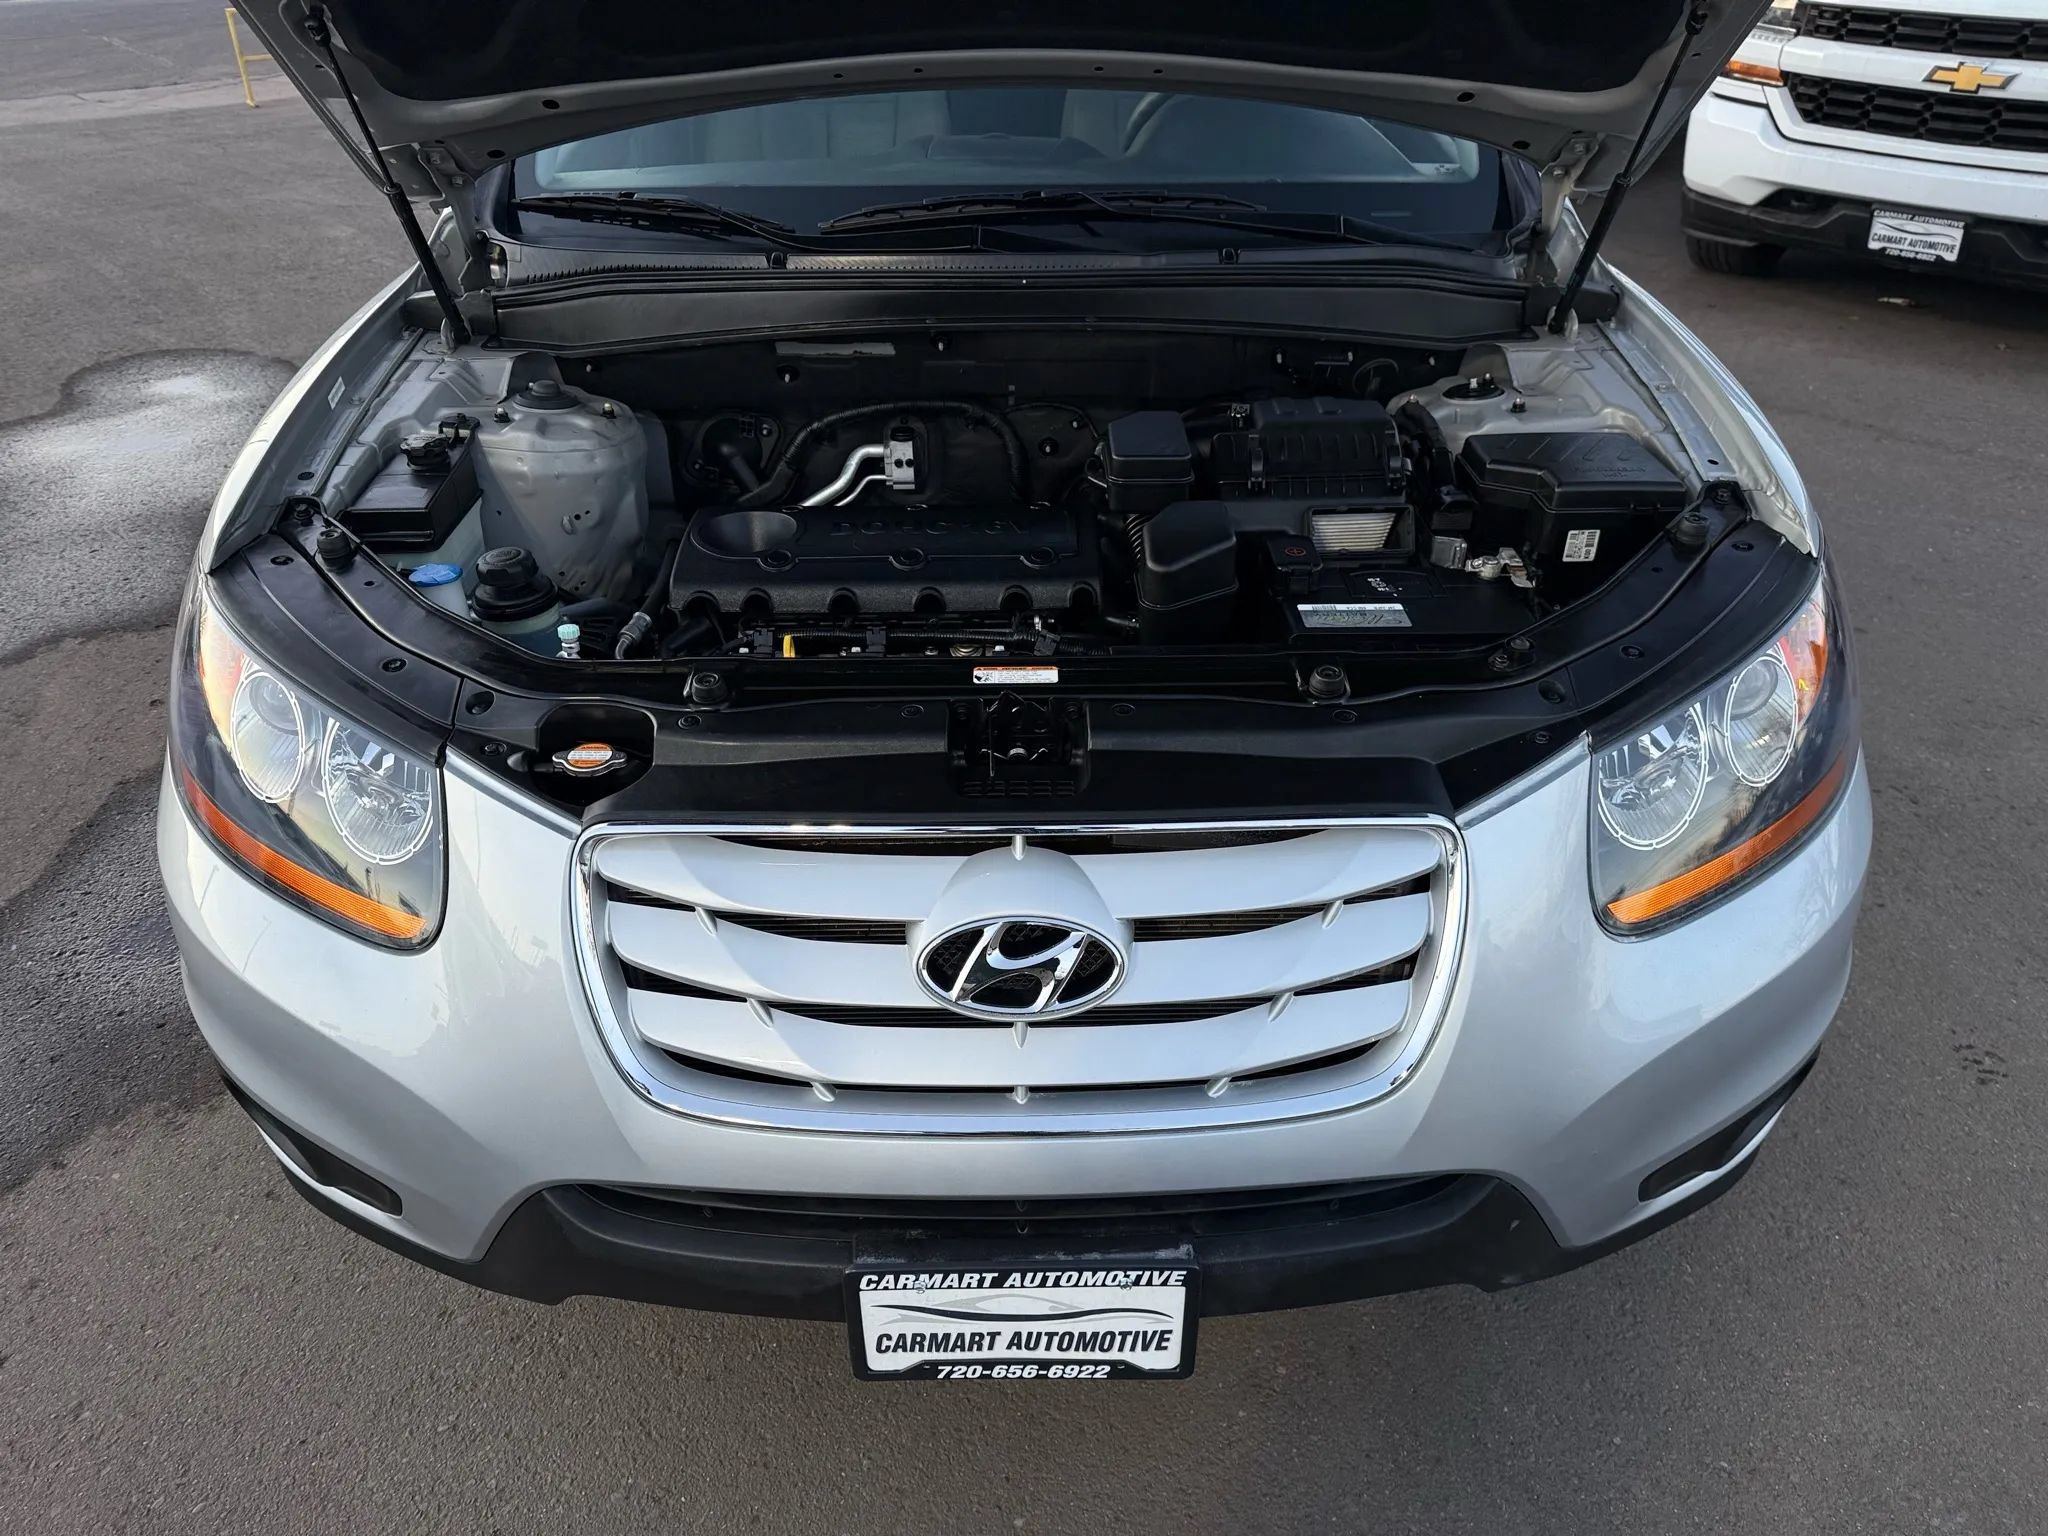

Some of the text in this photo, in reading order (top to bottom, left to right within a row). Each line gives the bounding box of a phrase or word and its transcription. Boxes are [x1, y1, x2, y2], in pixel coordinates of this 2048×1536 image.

[1873, 210, 1965, 228] CARMART AUTOMOTIVE
[1871, 233, 1957, 253] CARMART AUTOMOTIVE
[859, 1270, 1187, 1290] CARMART AUTOMOTIVE
[875, 1329, 1174, 1354] CARMART AUTOMOTIVE
[936, 1364, 1112, 1379] 720-656-6922
